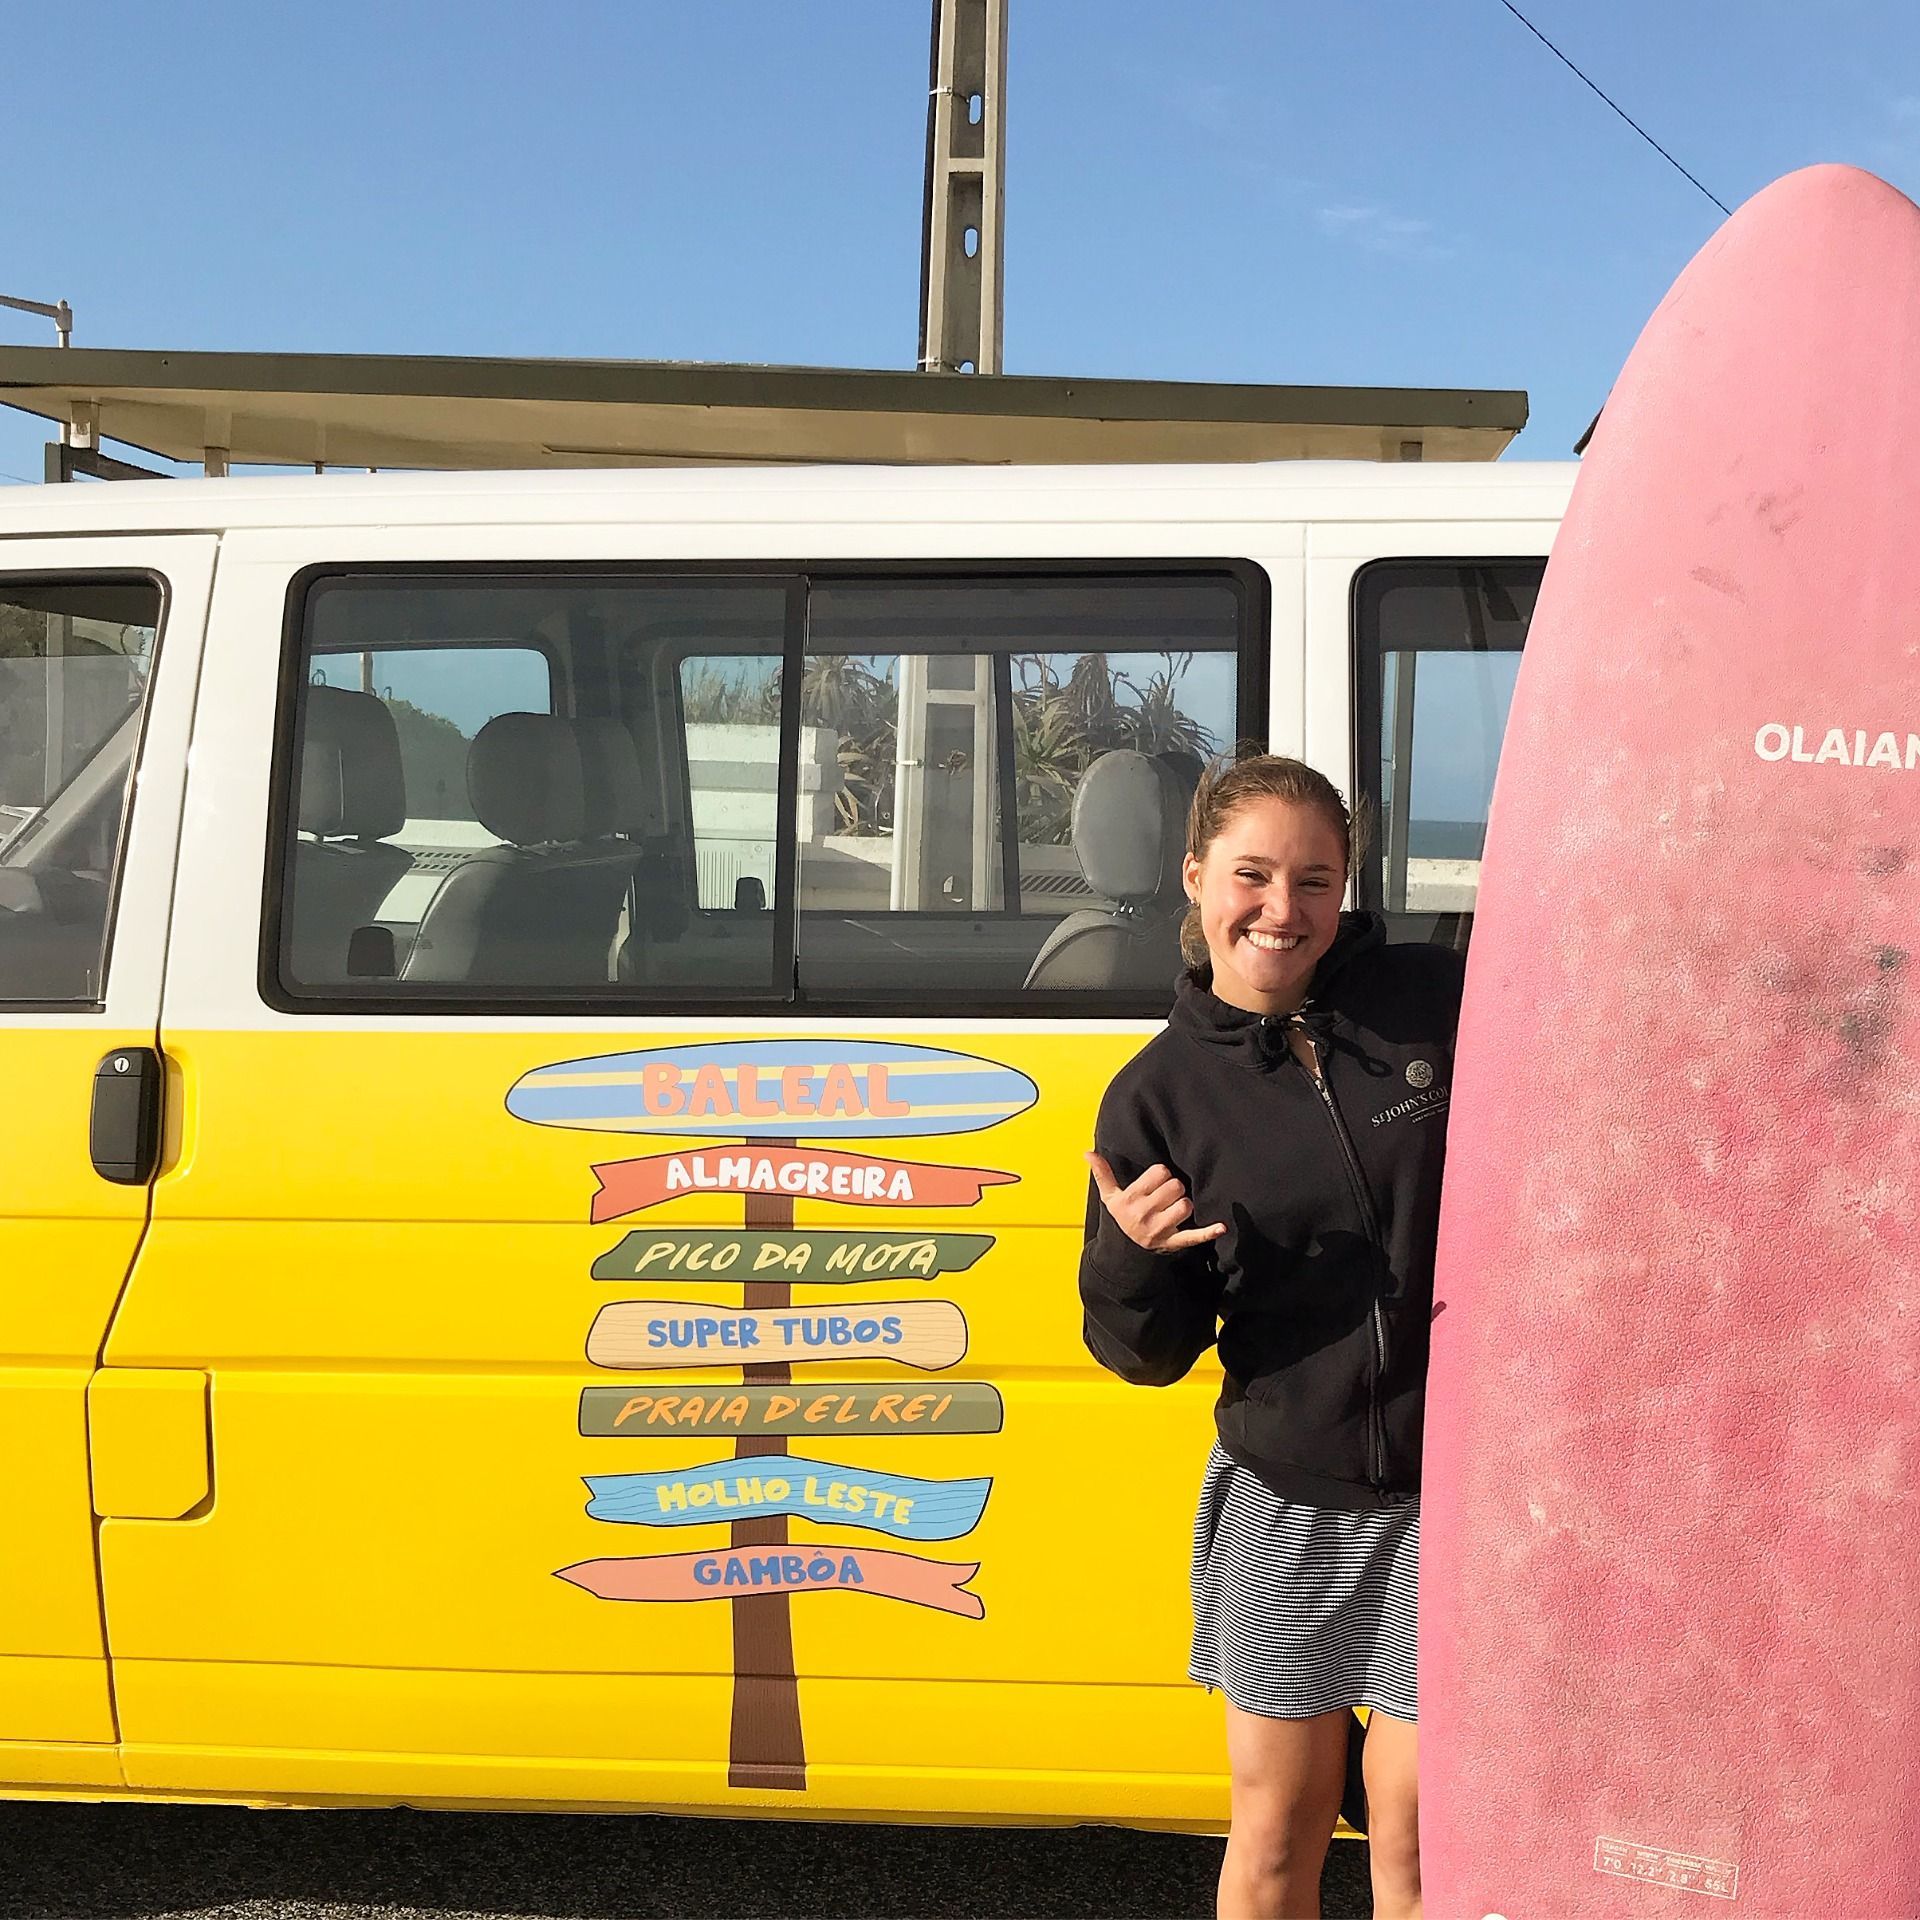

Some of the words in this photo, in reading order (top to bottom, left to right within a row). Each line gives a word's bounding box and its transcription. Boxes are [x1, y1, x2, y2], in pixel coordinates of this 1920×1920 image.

[642, 1062, 910, 1117] BALEAL
[1384, 1093, 1429, 1123] JOHN'S
[666, 1156, 915, 1201] ALMAGREIRA
[634, 1241, 740, 1274] PICO
[752, 1243, 811, 1274] DA
[825, 1239, 940, 1275] MOTA
[647, 1317, 760, 1349] SUPER
[772, 1316, 903, 1346] TUBOS
[614, 1395, 750, 1428] PRAIA
[869, 1393, 953, 1423] REI
[656, 1477, 791, 1513] MOLHO
[804, 1476, 914, 1525] LESTE
[693, 1550, 865, 1587] GAMBÔA
